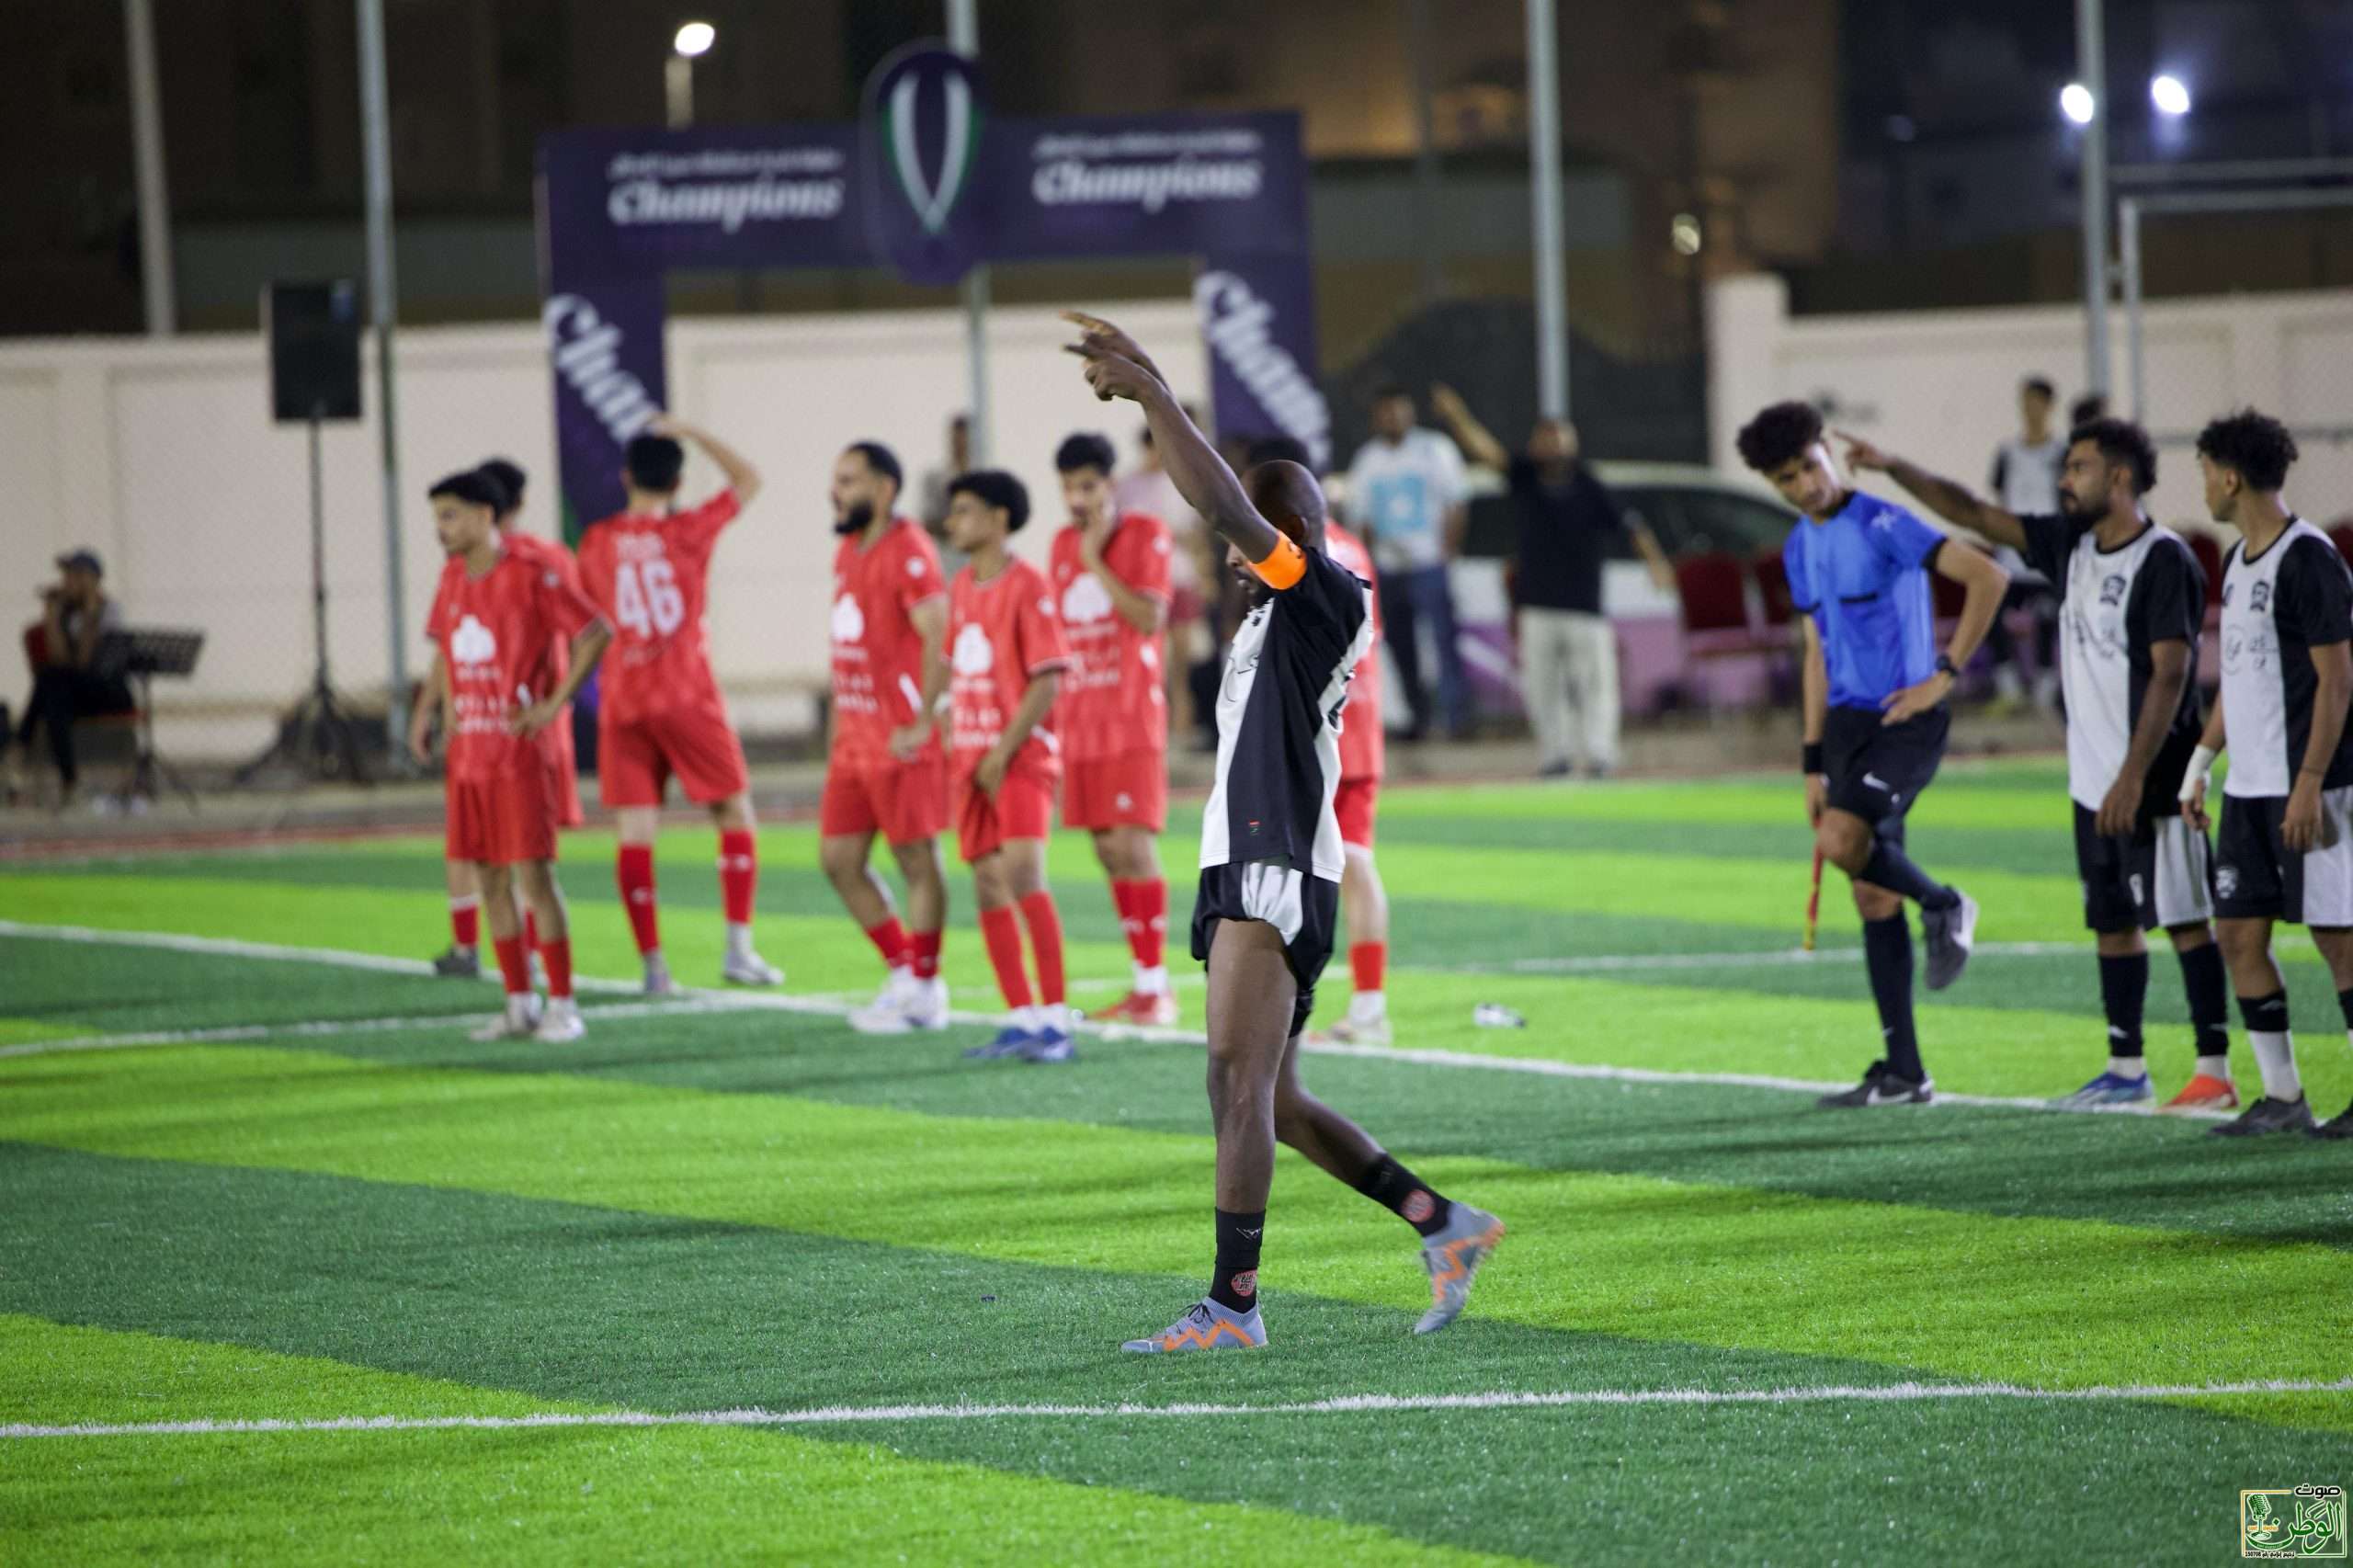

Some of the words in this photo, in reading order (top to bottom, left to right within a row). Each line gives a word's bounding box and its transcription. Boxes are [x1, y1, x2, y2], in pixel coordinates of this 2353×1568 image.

[608, 177, 841, 232] Champions
[1032, 160, 1259, 212] Champions
[615, 560, 686, 639] 46
